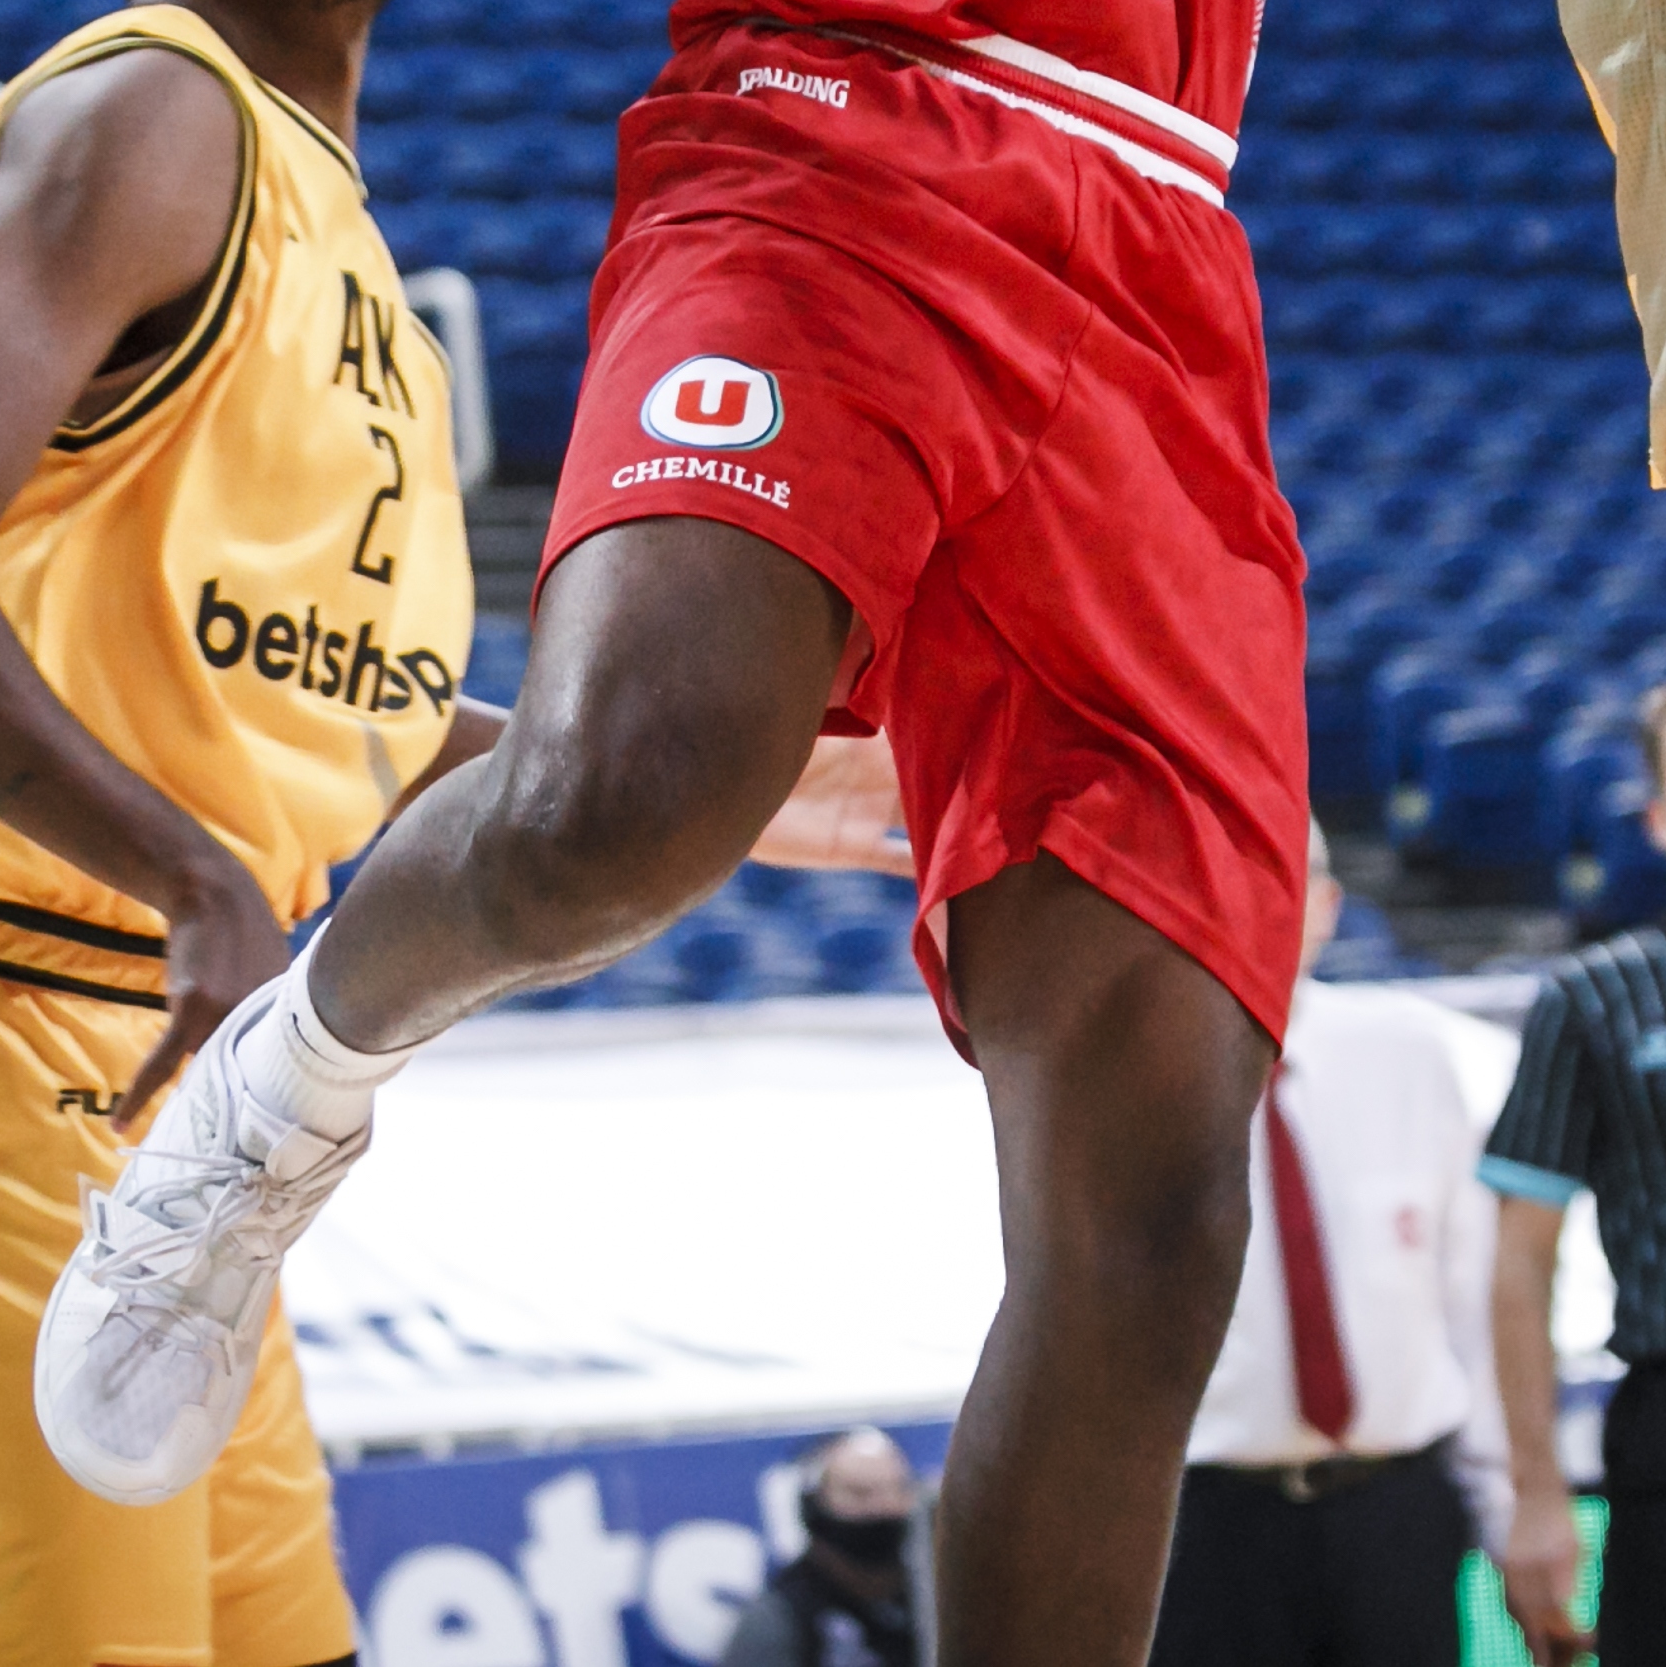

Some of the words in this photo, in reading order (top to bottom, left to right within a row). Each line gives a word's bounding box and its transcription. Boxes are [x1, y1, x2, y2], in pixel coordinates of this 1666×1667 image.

[736, 67, 850, 109] SPALDING
[675, 380, 751, 426] U
[352, 423, 405, 584] 2
[611, 456, 791, 509] CHEMILLÉ
